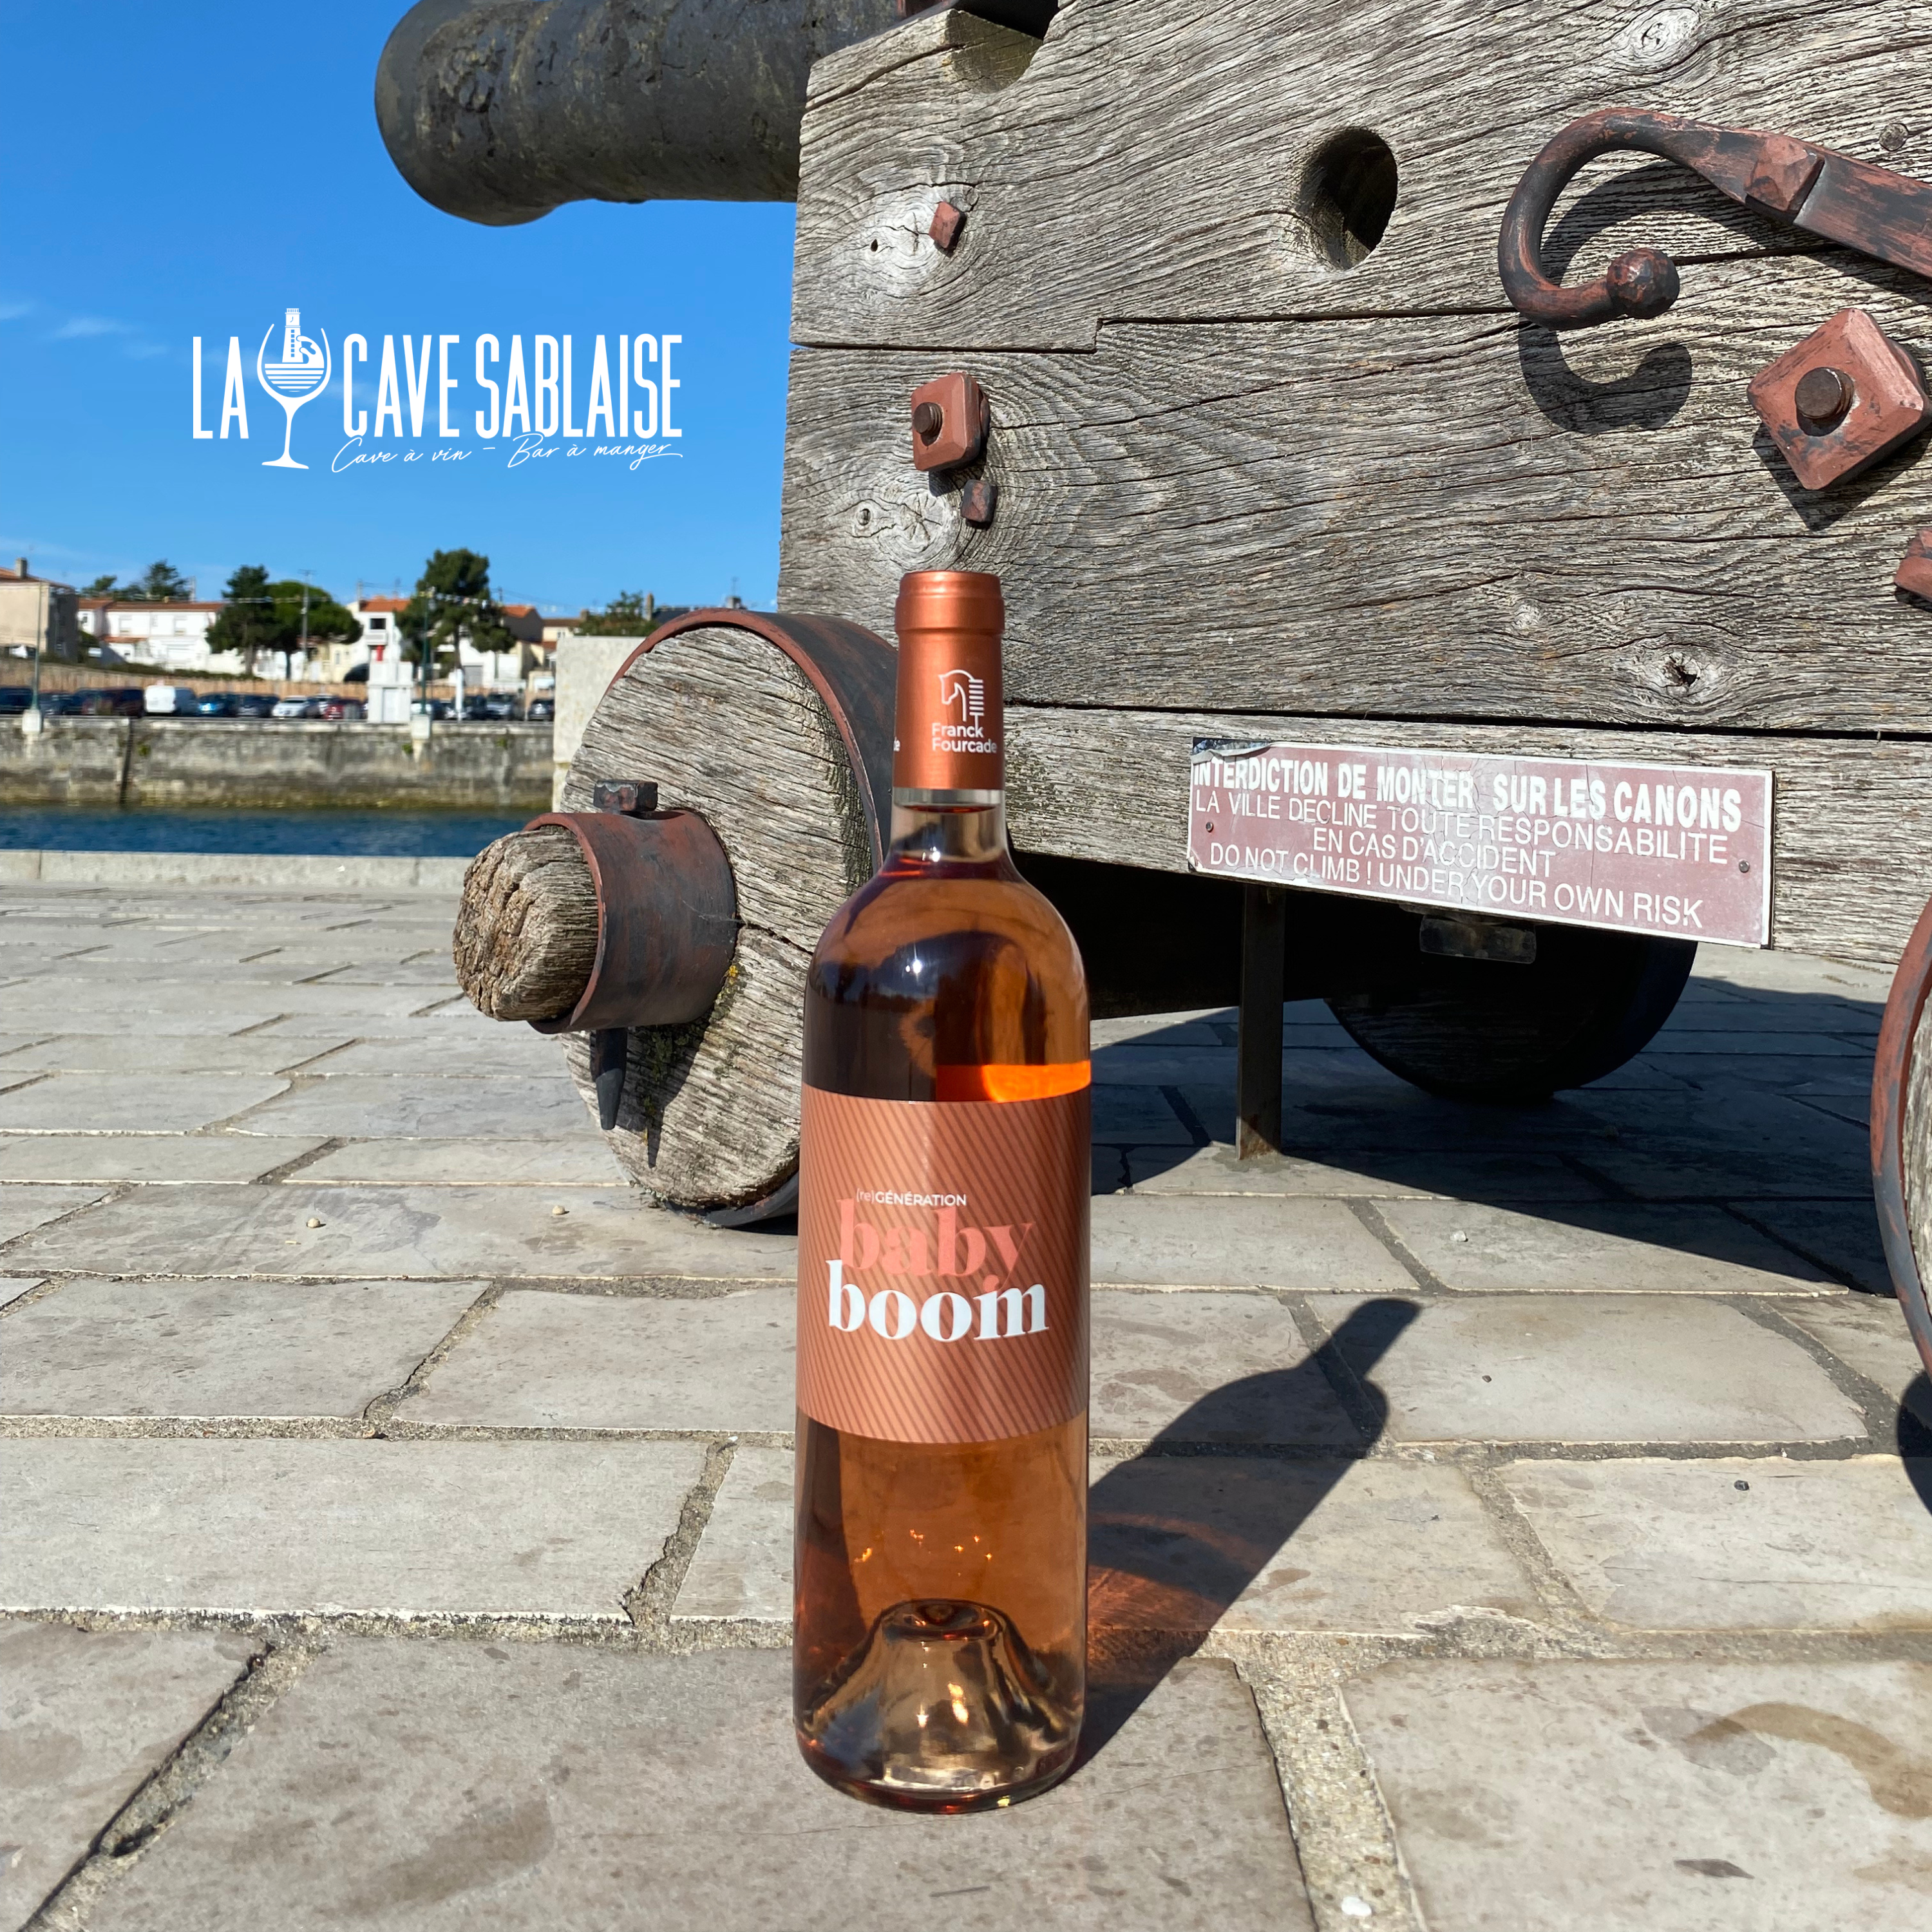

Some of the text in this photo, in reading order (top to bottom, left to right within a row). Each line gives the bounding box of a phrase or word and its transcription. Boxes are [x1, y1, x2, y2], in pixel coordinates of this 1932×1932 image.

[931, 721, 984, 738] Franck
[931, 737, 997, 753] Fourcade
[1194, 756, 1741, 832] INTERDICTION DE MONTER SUR LES CANONS
[1196, 790, 1728, 864] LA VILLE DECLINE TOUTE RESPONSABILITE
[1210, 842, 1240, 867] DO
[1245, 846, 1289, 873] NOT
[1293, 853, 1360, 883] CLIMB
[1379, 864, 1463, 897] UNDER
[1472, 874, 1546, 908] YOUR
[1554, 883, 1624, 918] OWN
[1633, 893, 1703, 928] RISK
[1313, 828, 1555, 877] EN CAS D'ACCIDENT
[855, 1188, 966, 1206] (re)GÉNÉRATION
[837, 1198, 1037, 1294] baby
[825, 1260, 1050, 1342] boom
